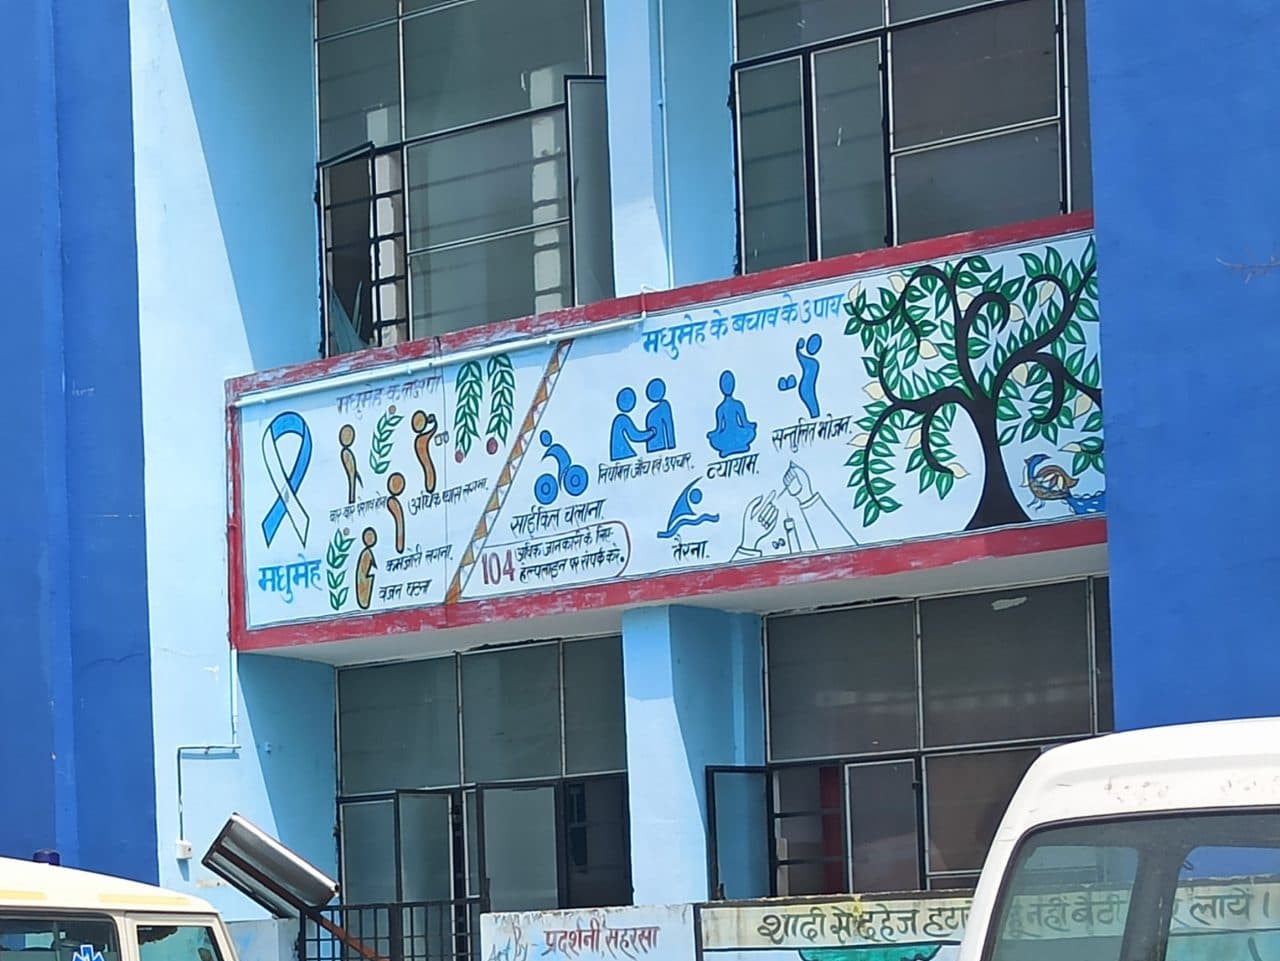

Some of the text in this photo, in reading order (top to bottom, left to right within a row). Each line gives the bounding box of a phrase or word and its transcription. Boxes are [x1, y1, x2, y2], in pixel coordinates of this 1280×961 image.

[641, 293, 845, 360] मधुमेह के बचाव के उपाय
[258, 553, 323, 605] मधुमेह
[482, 550, 516, 585] 104
[757, 906, 827, 945] शादी
[855, 903, 921, 942] दहेज
